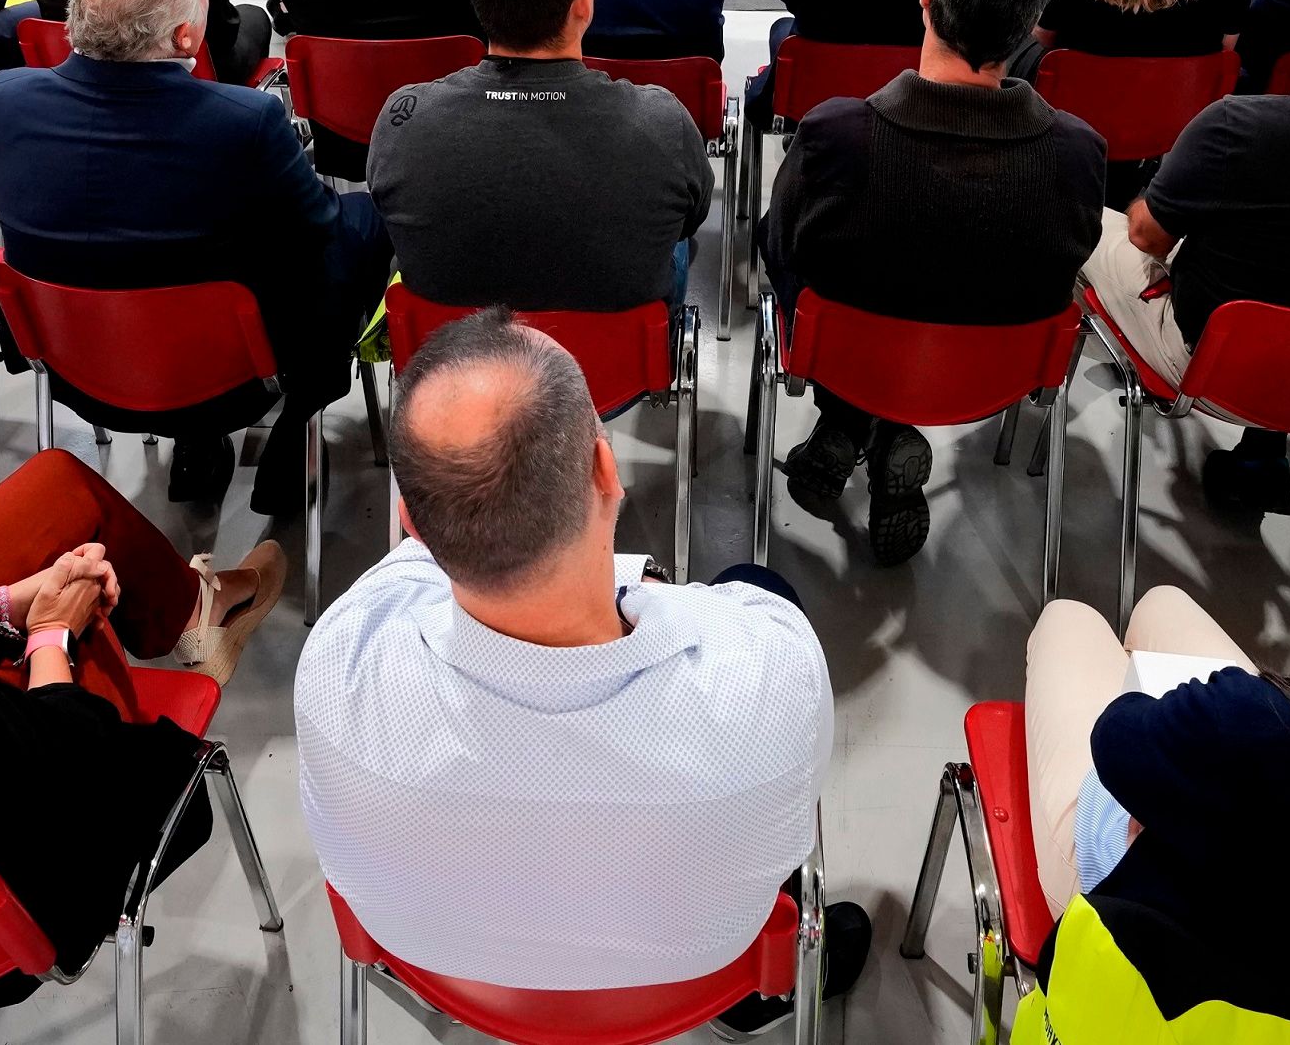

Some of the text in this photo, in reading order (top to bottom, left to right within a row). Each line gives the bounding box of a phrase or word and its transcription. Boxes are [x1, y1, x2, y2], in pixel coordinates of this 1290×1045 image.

[485, 90, 566, 101] TRUST IN MOTION
